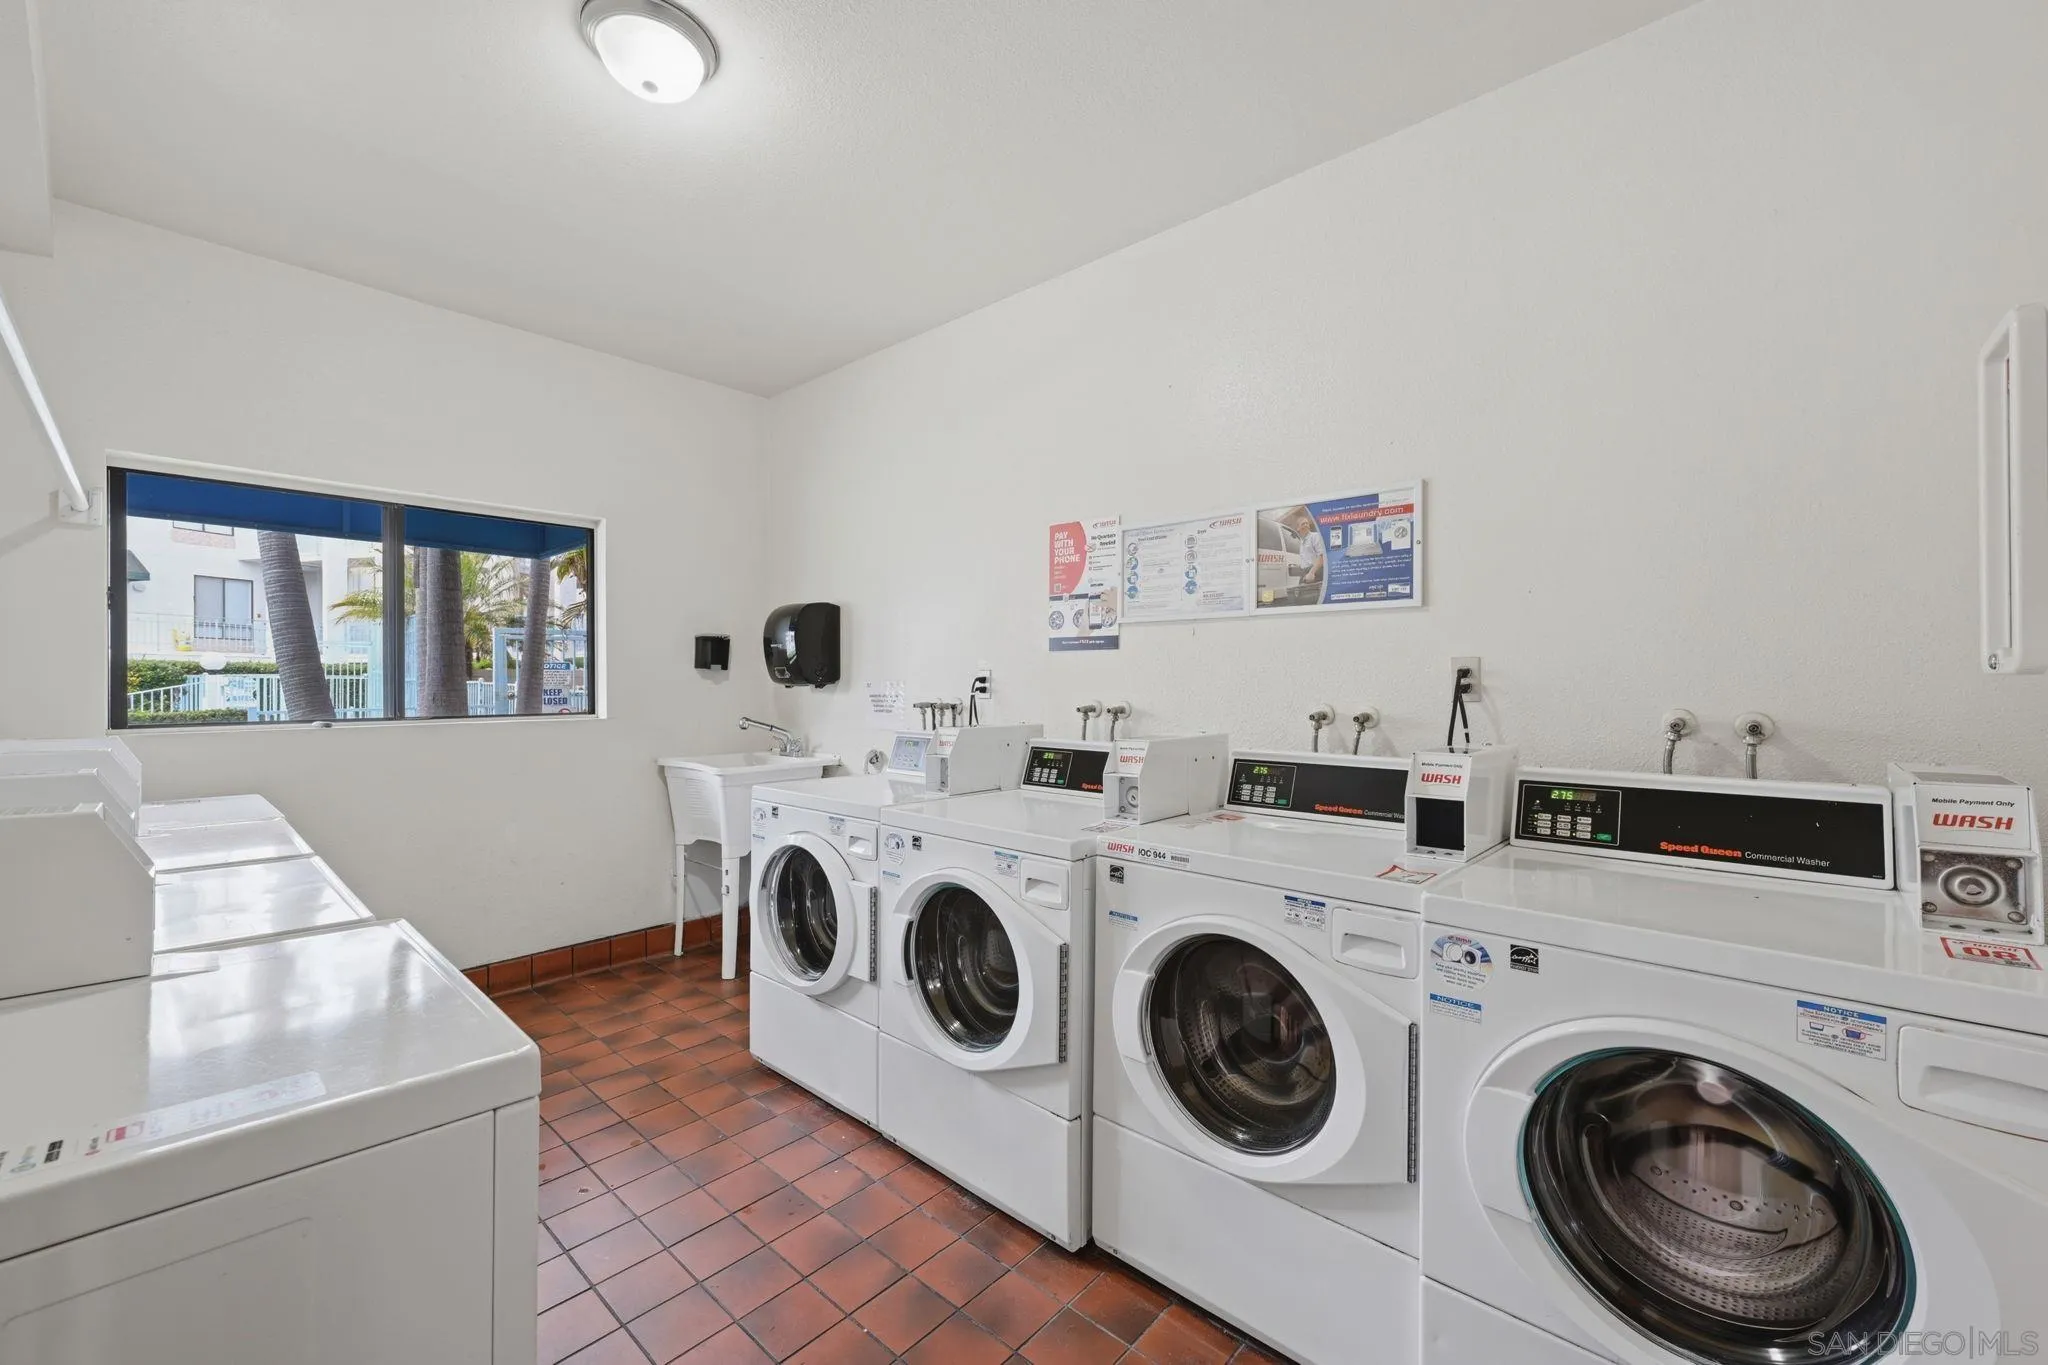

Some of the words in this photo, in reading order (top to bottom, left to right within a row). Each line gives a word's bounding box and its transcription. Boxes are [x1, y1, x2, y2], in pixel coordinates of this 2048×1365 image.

[1055, 532, 1068, 540] PAY
[1055, 539, 1073, 548] WITH
[1055, 547, 1074, 556] YOUR
[1055, 555, 1080, 564] PHONE
[1119, 755, 1144, 764] WASH
[1421, 772, 1467, 785] WASH
[1550, 790, 1573, 801] 2.75
[1314, 803, 1338, 814] Speed
[1959, 798, 1994, 807] Payment
[1995, 799, 2015, 808] Only
[1932, 812, 2014, 831] WASH
[1107, 842, 1135, 854] WASH
[1153, 850, 1166, 860] 944
[1659, 841, 1699, 853] Speed
[1700, 844, 1742, 858] Queen
[1744, 851, 1795, 864] Commercial
[1796, 856, 1831, 868] Washer
[1437, 995, 1474, 1007] NOTICE
[1823, 1005, 1860, 1018] NOTICE
